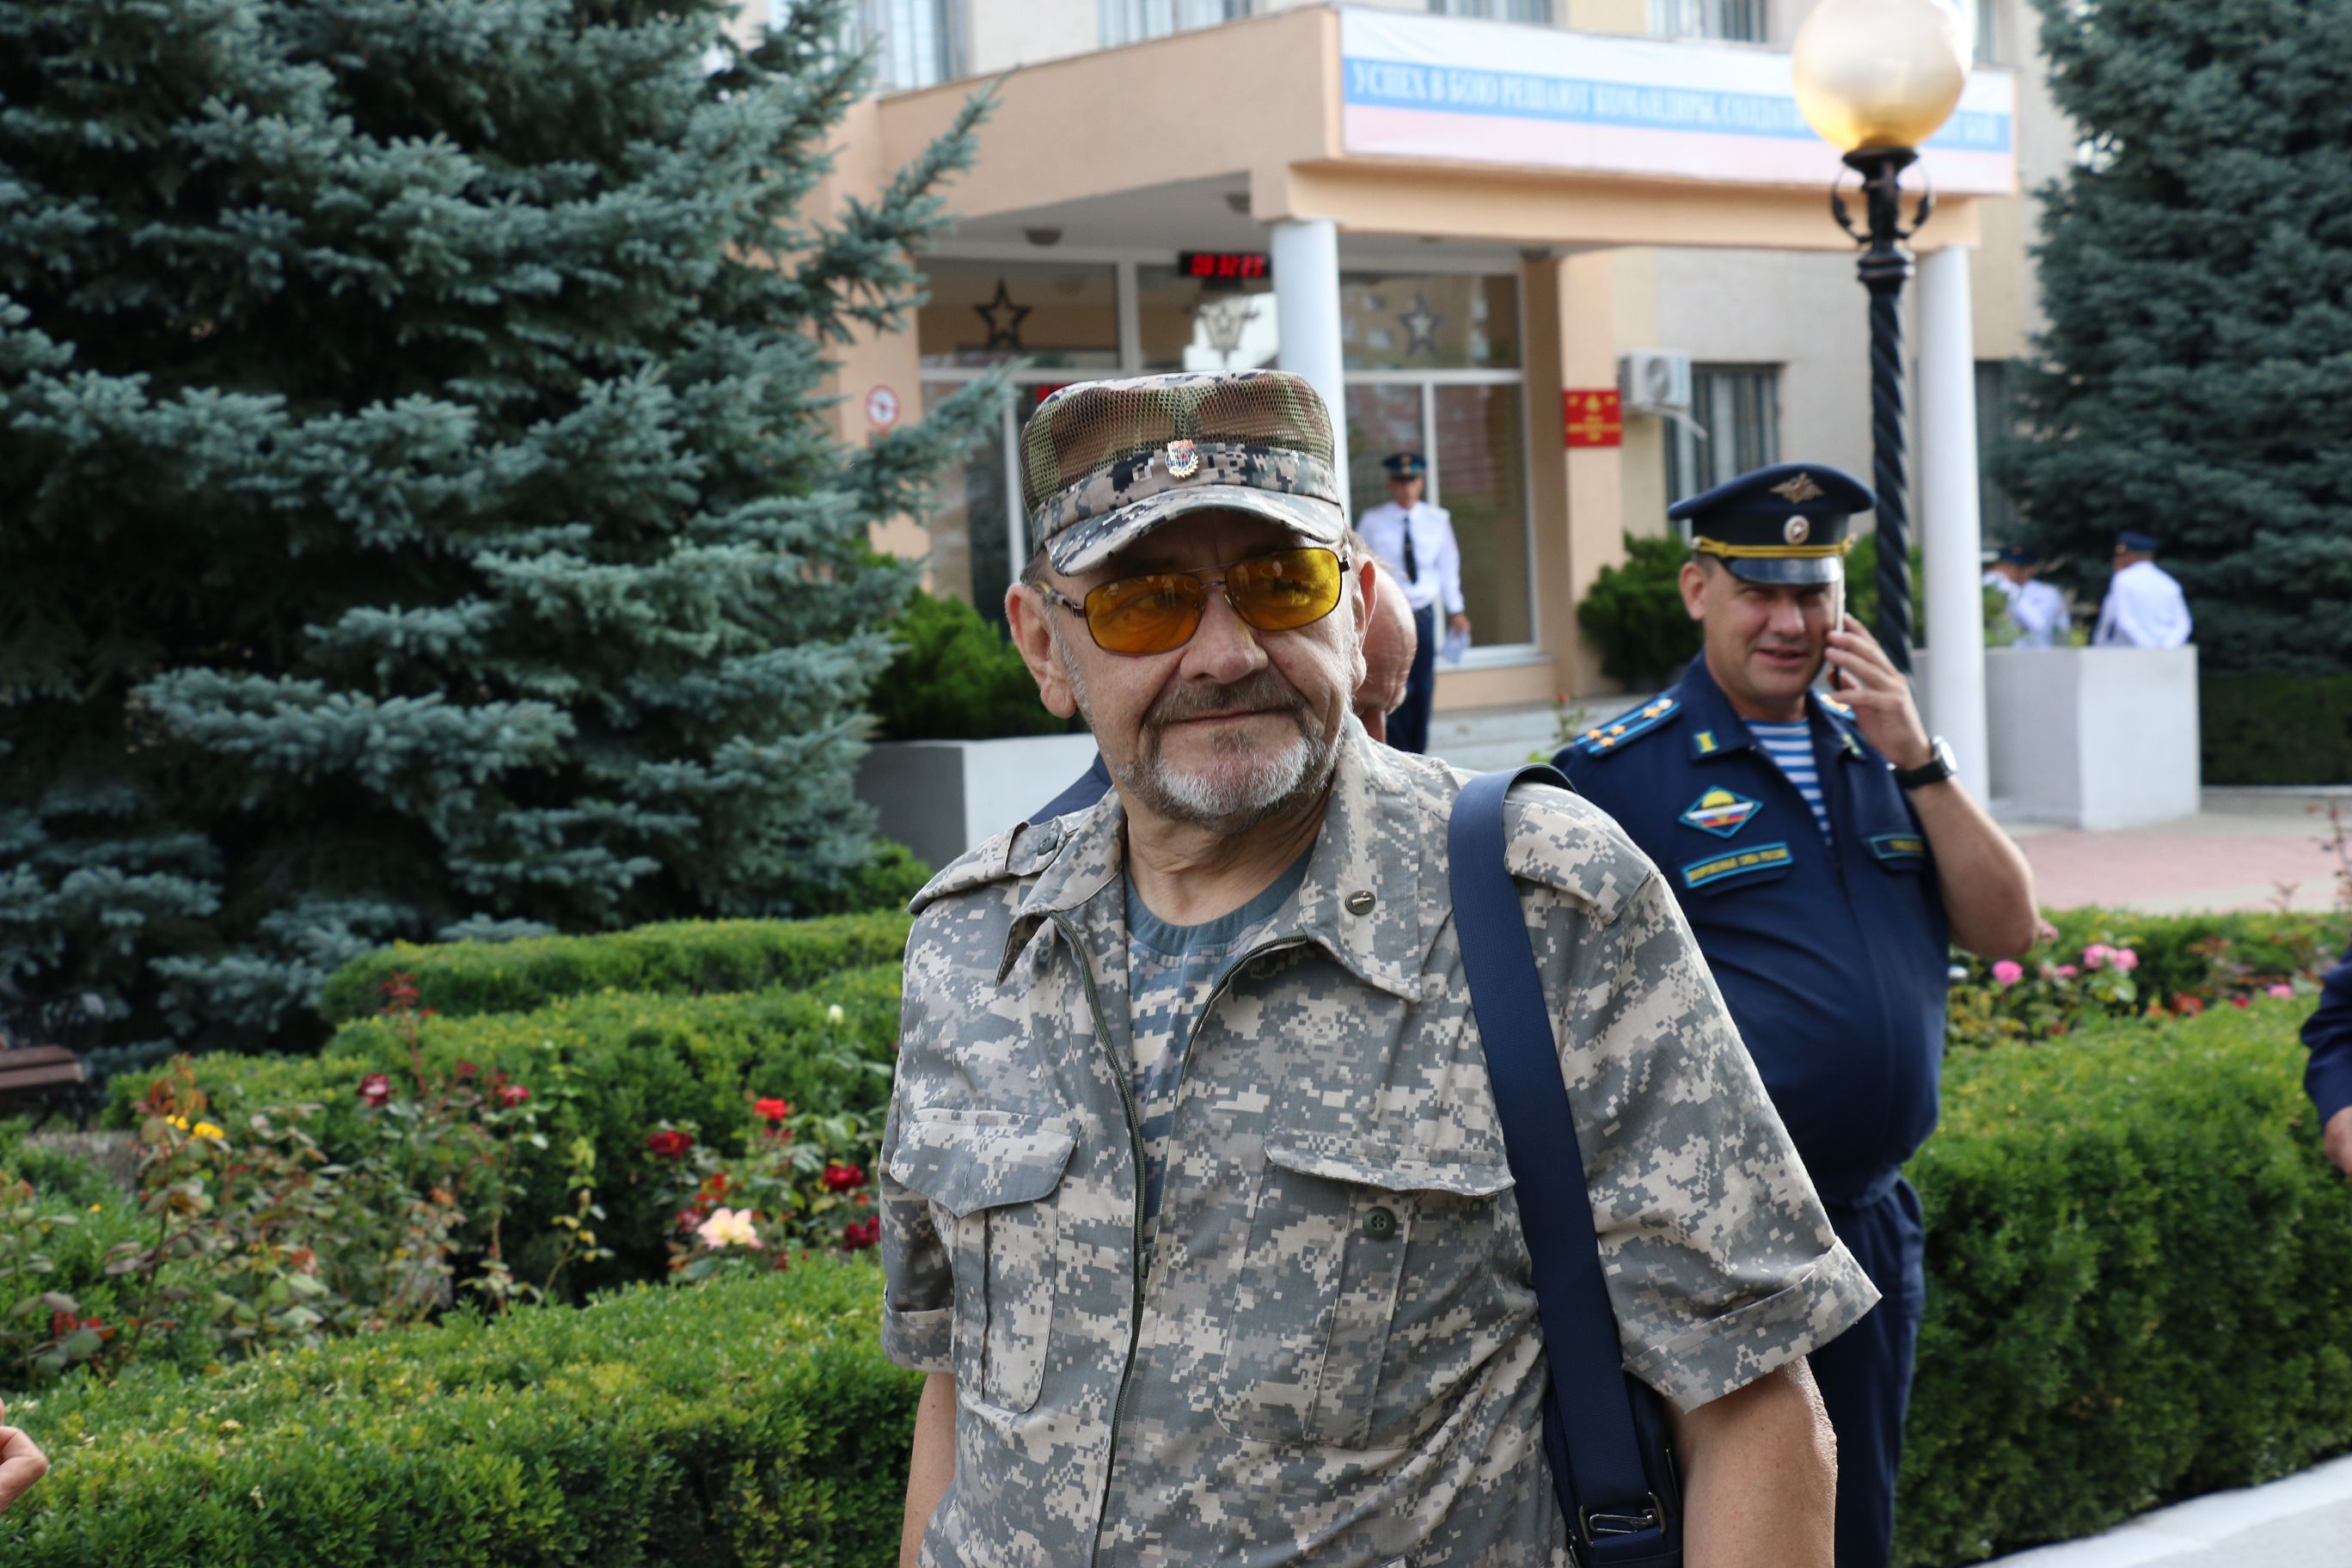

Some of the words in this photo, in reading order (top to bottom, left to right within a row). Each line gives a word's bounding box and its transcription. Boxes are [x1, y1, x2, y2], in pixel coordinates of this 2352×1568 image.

[1352, 61, 1427, 100] УСПЕХ
[1430, 68, 1445, 102] В
[1448, 70, 1499, 107] БОЮ
